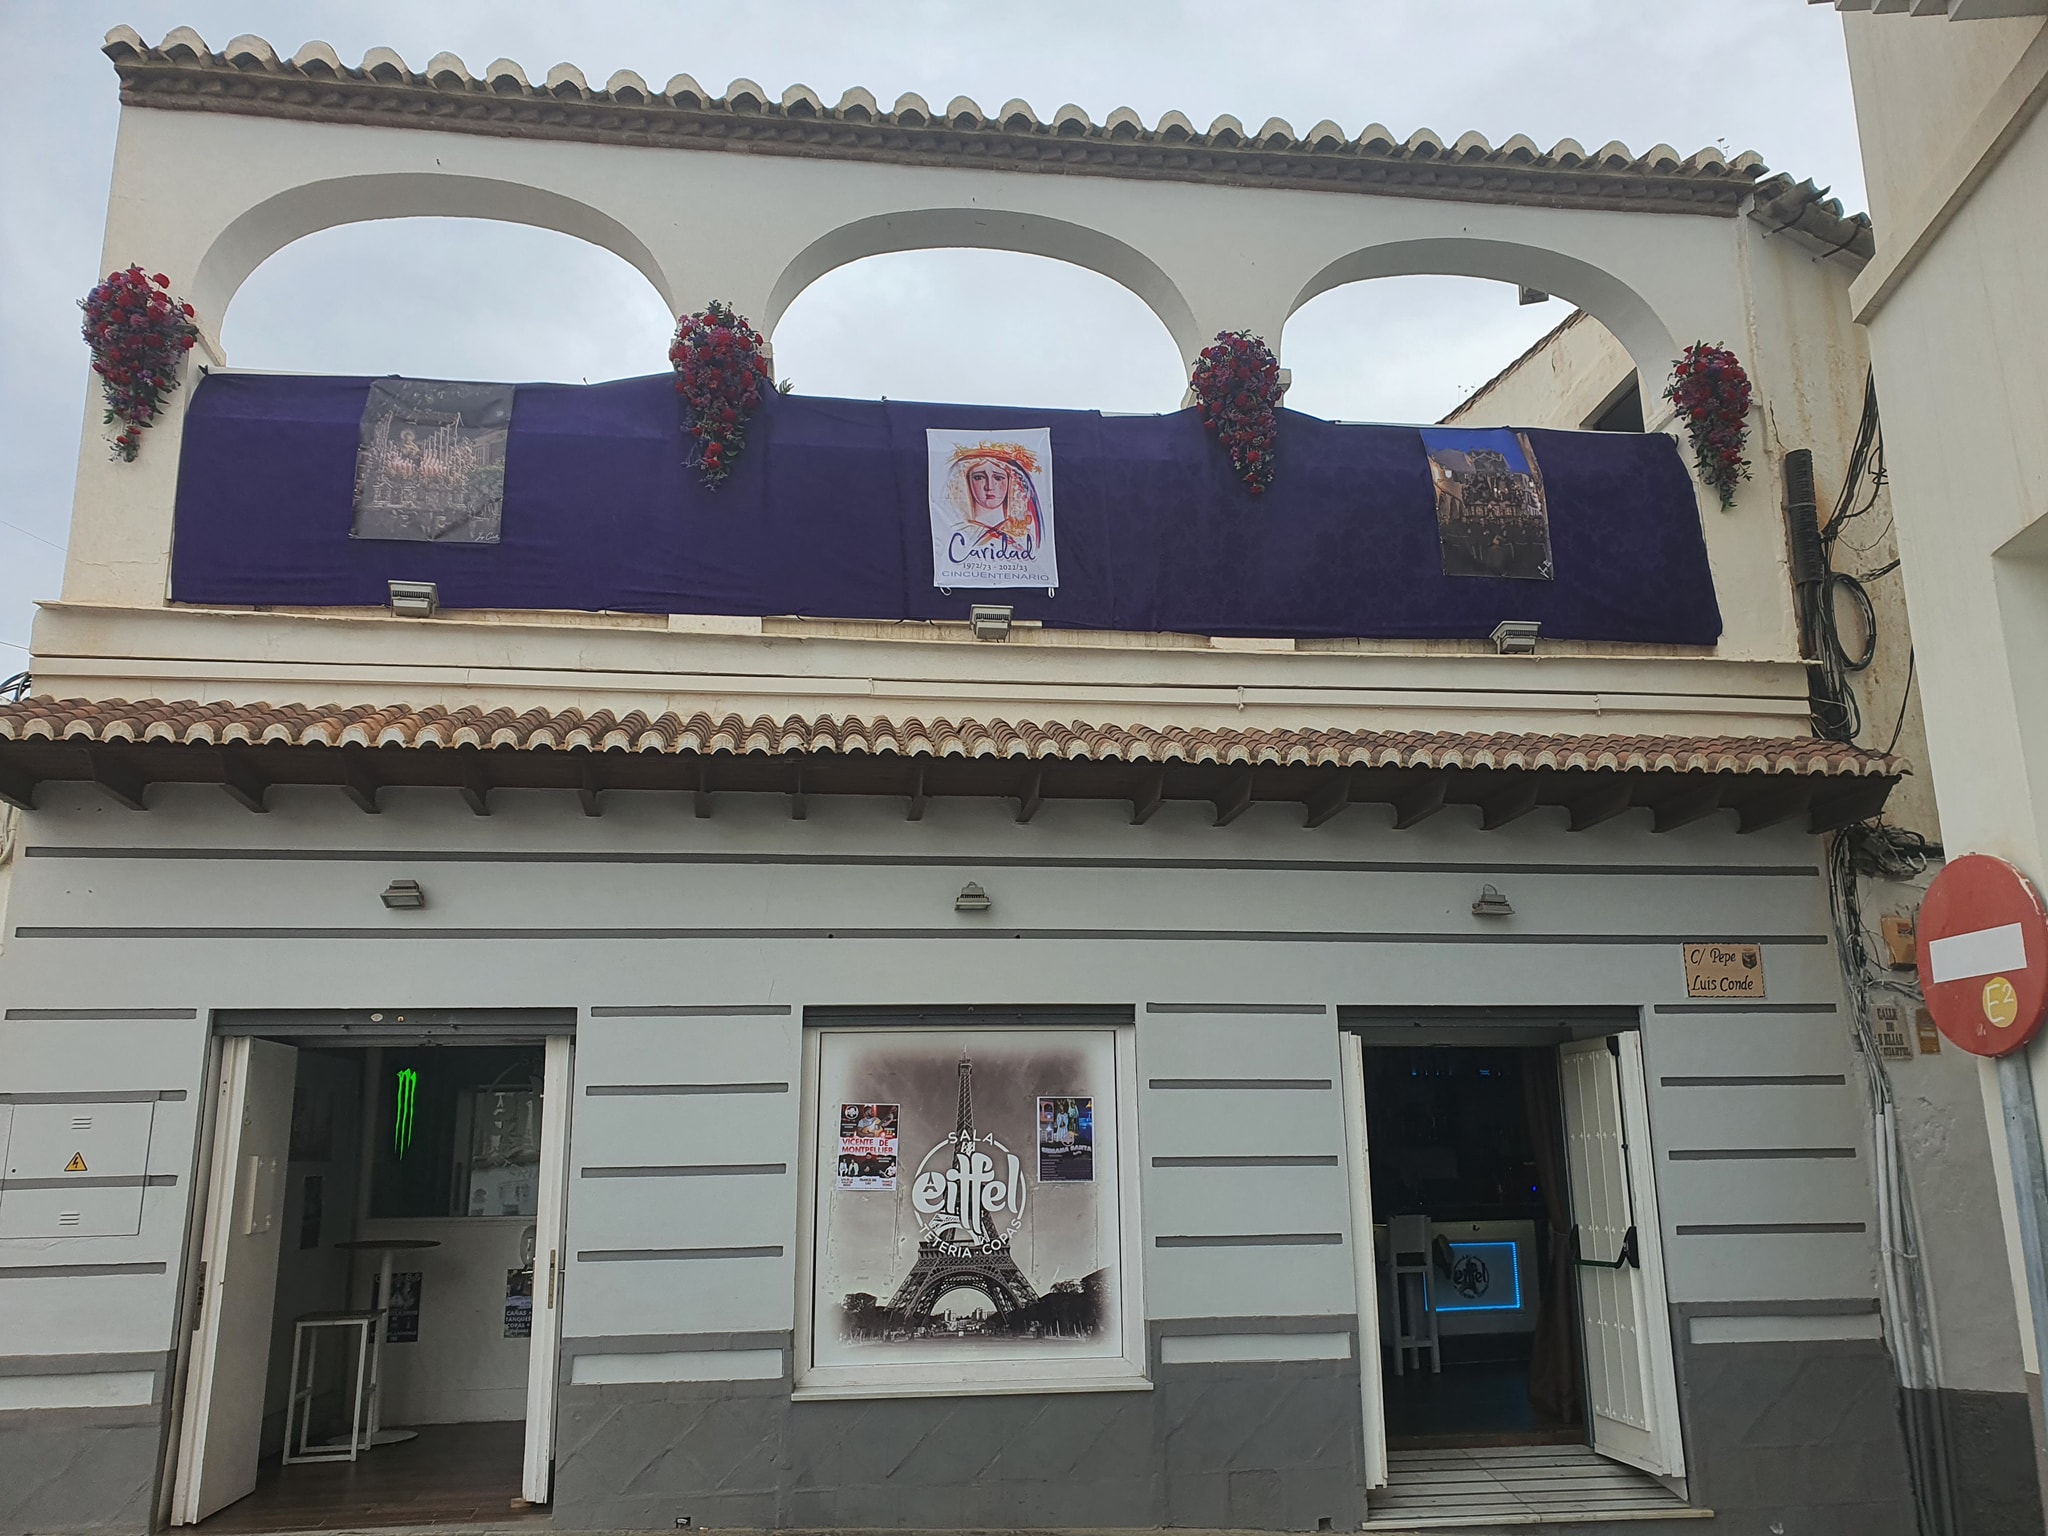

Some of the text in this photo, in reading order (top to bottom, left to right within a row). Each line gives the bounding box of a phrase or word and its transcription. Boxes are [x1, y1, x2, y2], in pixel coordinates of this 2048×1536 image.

[949, 532, 1036, 563] Caridad
[963, 562, 991, 571] 1972/73
[941, 570, 1050, 581] CINCUENTENARIO
[1690, 947, 1736, 966] C/ Pepe
[1691, 975, 1754, 992] Luis Conde
[1876, 1008, 1898, 1020] CALLE
[842, 1138, 889, 1147] VICENTE DE
[948, 1129, 994, 1146] SALA
[841, 1146, 894, 1154] MONTPELLIER
[911, 1152, 1020, 1235] eiffel
[919, 1218, 1022, 1258] TETERIA COPAS
